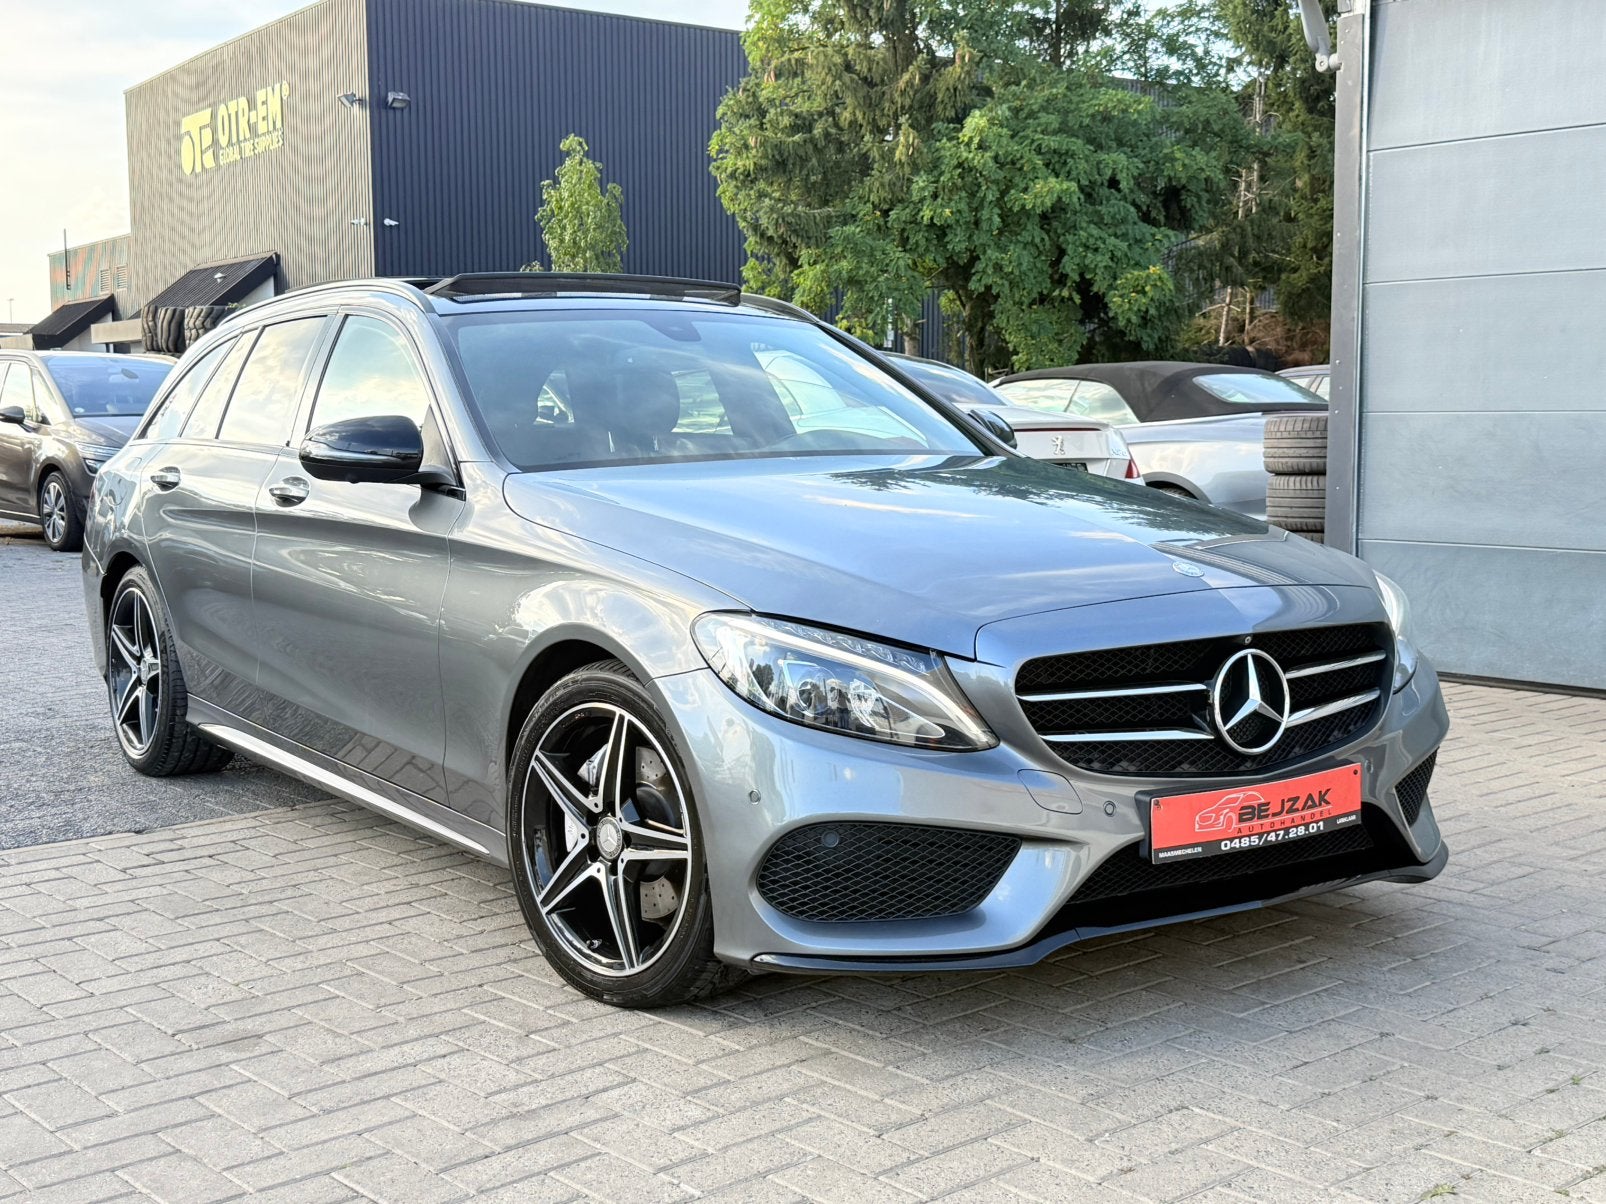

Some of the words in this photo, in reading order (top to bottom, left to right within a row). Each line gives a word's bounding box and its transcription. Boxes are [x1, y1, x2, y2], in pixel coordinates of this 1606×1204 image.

[1238, 788, 1332, 823] BEJZAK
[1220, 821, 1325, 852] 0485/47.28.01
[1236, 808, 1333, 835] AUTOHANDEL
